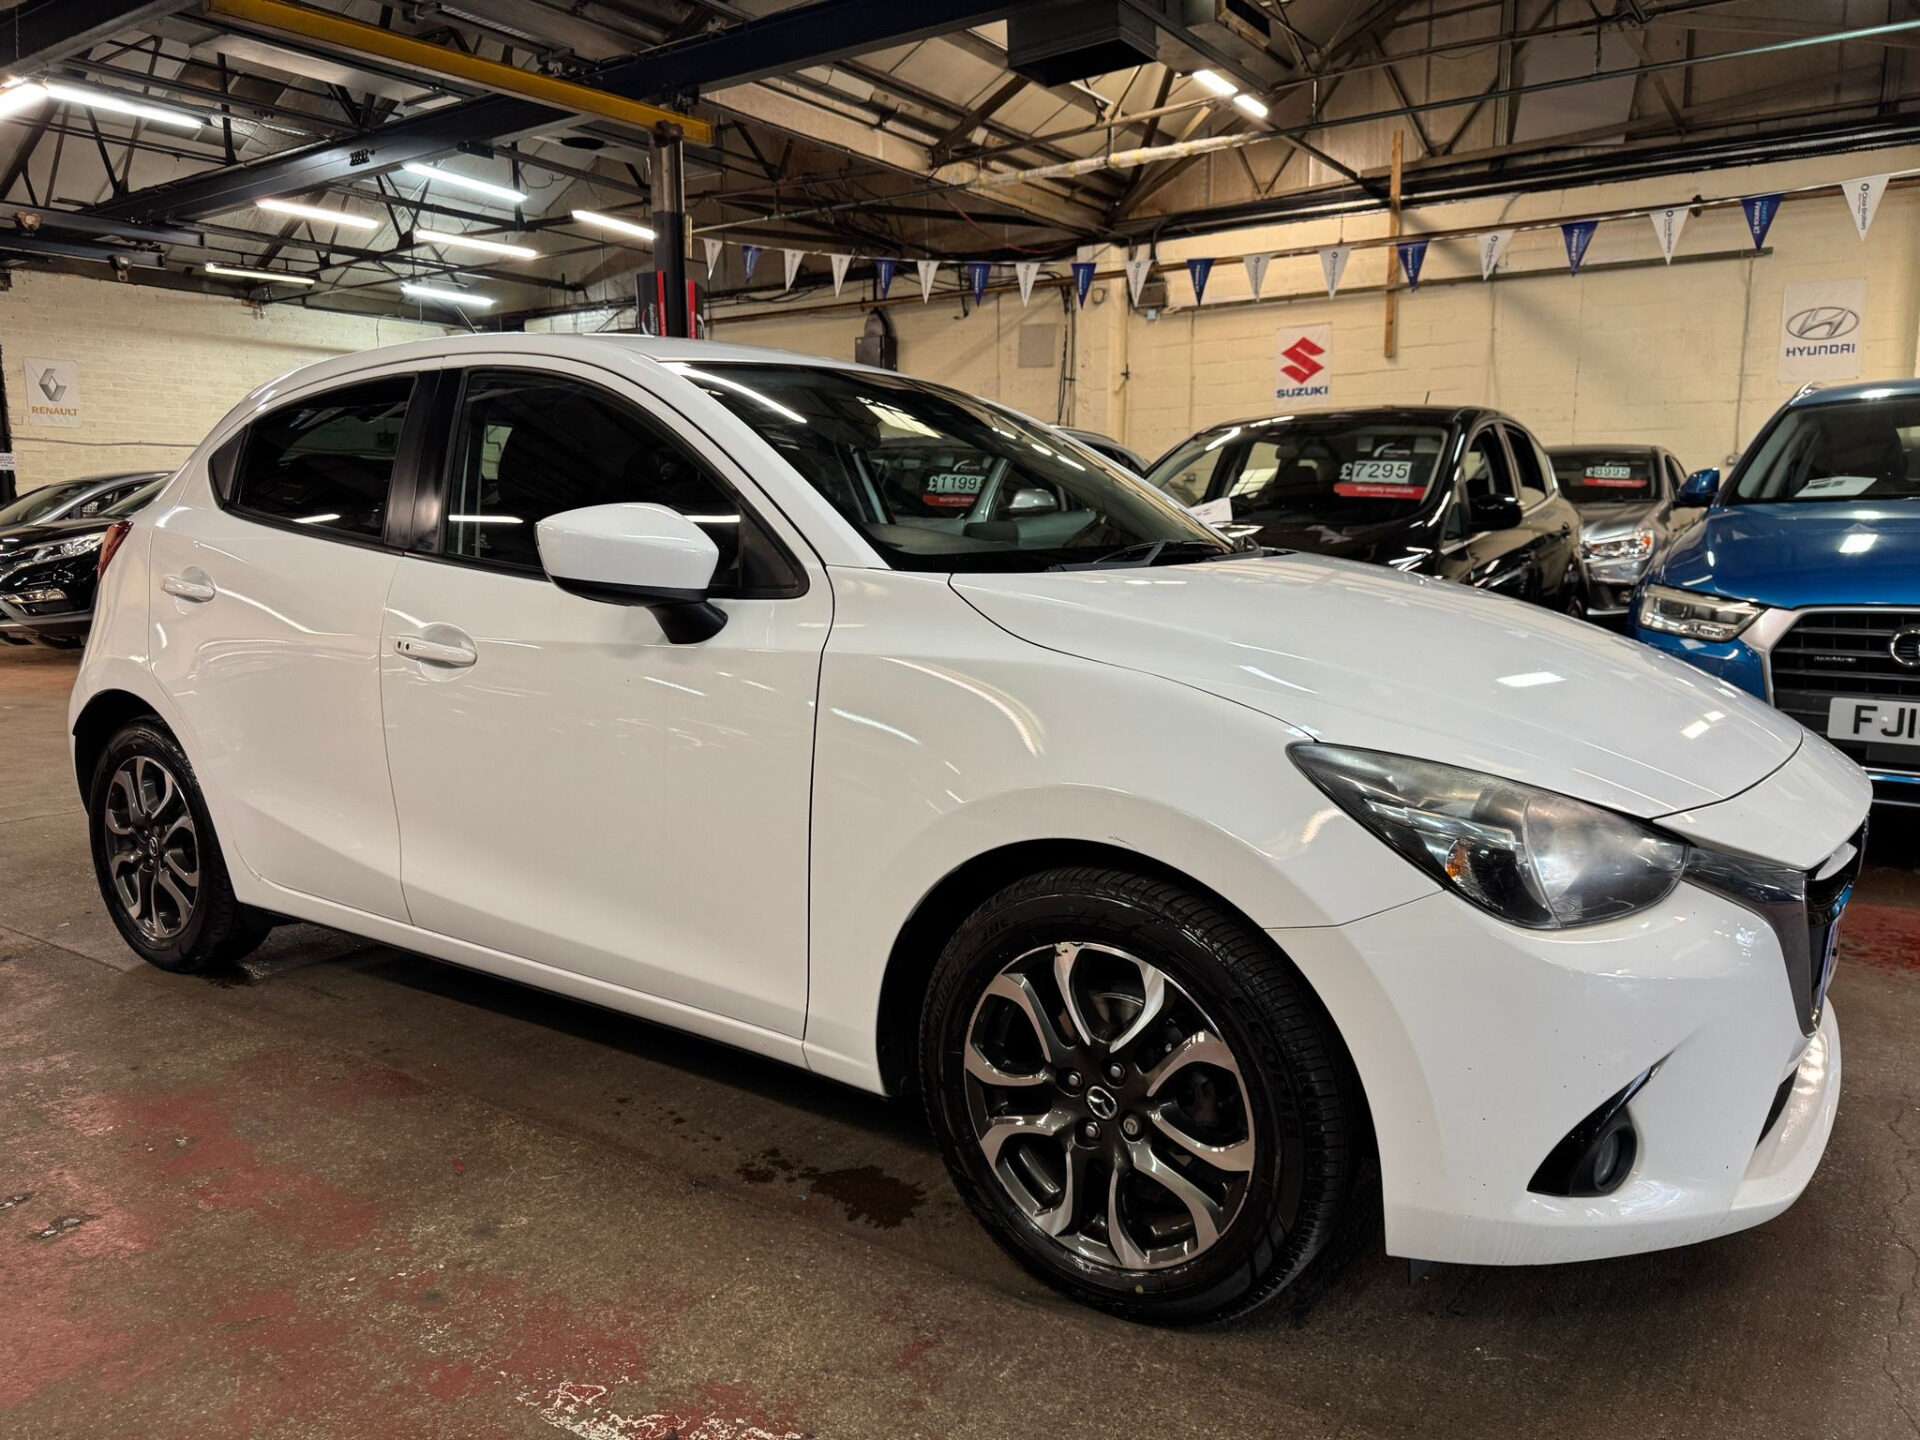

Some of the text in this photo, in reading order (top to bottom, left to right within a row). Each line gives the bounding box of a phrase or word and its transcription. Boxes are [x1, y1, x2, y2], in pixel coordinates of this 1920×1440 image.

[1786, 343, 1855, 357] HYUNDAI
[1276, 386, 1328, 398] SUZUKI
[31, 406, 79, 416] RENAULT
[1339, 462, 1408, 480] £7295
